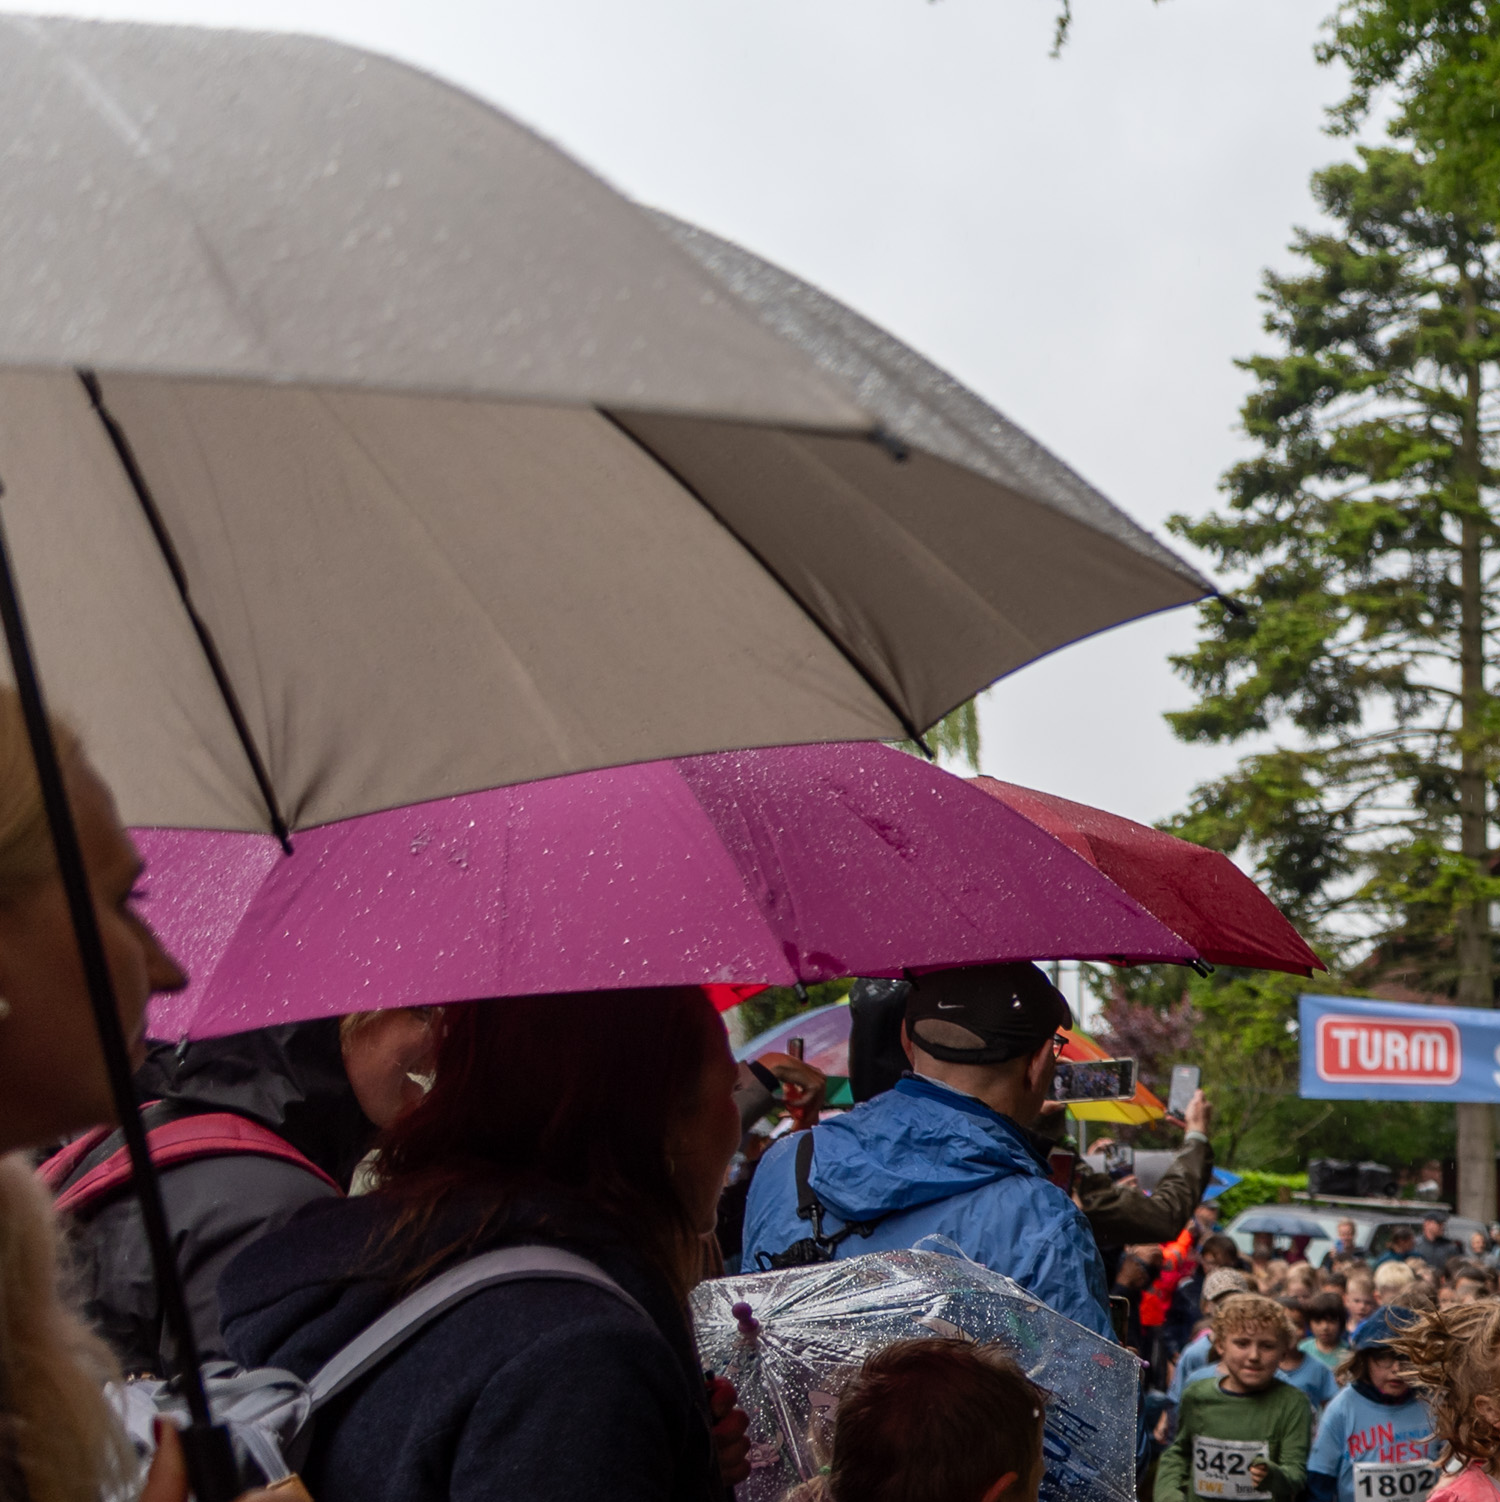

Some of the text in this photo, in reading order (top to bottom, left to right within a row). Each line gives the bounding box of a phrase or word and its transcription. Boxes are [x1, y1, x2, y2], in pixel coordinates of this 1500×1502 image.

[1330, 1027, 1449, 1073] TURM
[1347, 1421, 1395, 1458] RUN
[1196, 1448, 1265, 1475] 342
[1358, 1469, 1435, 1498] 1802
